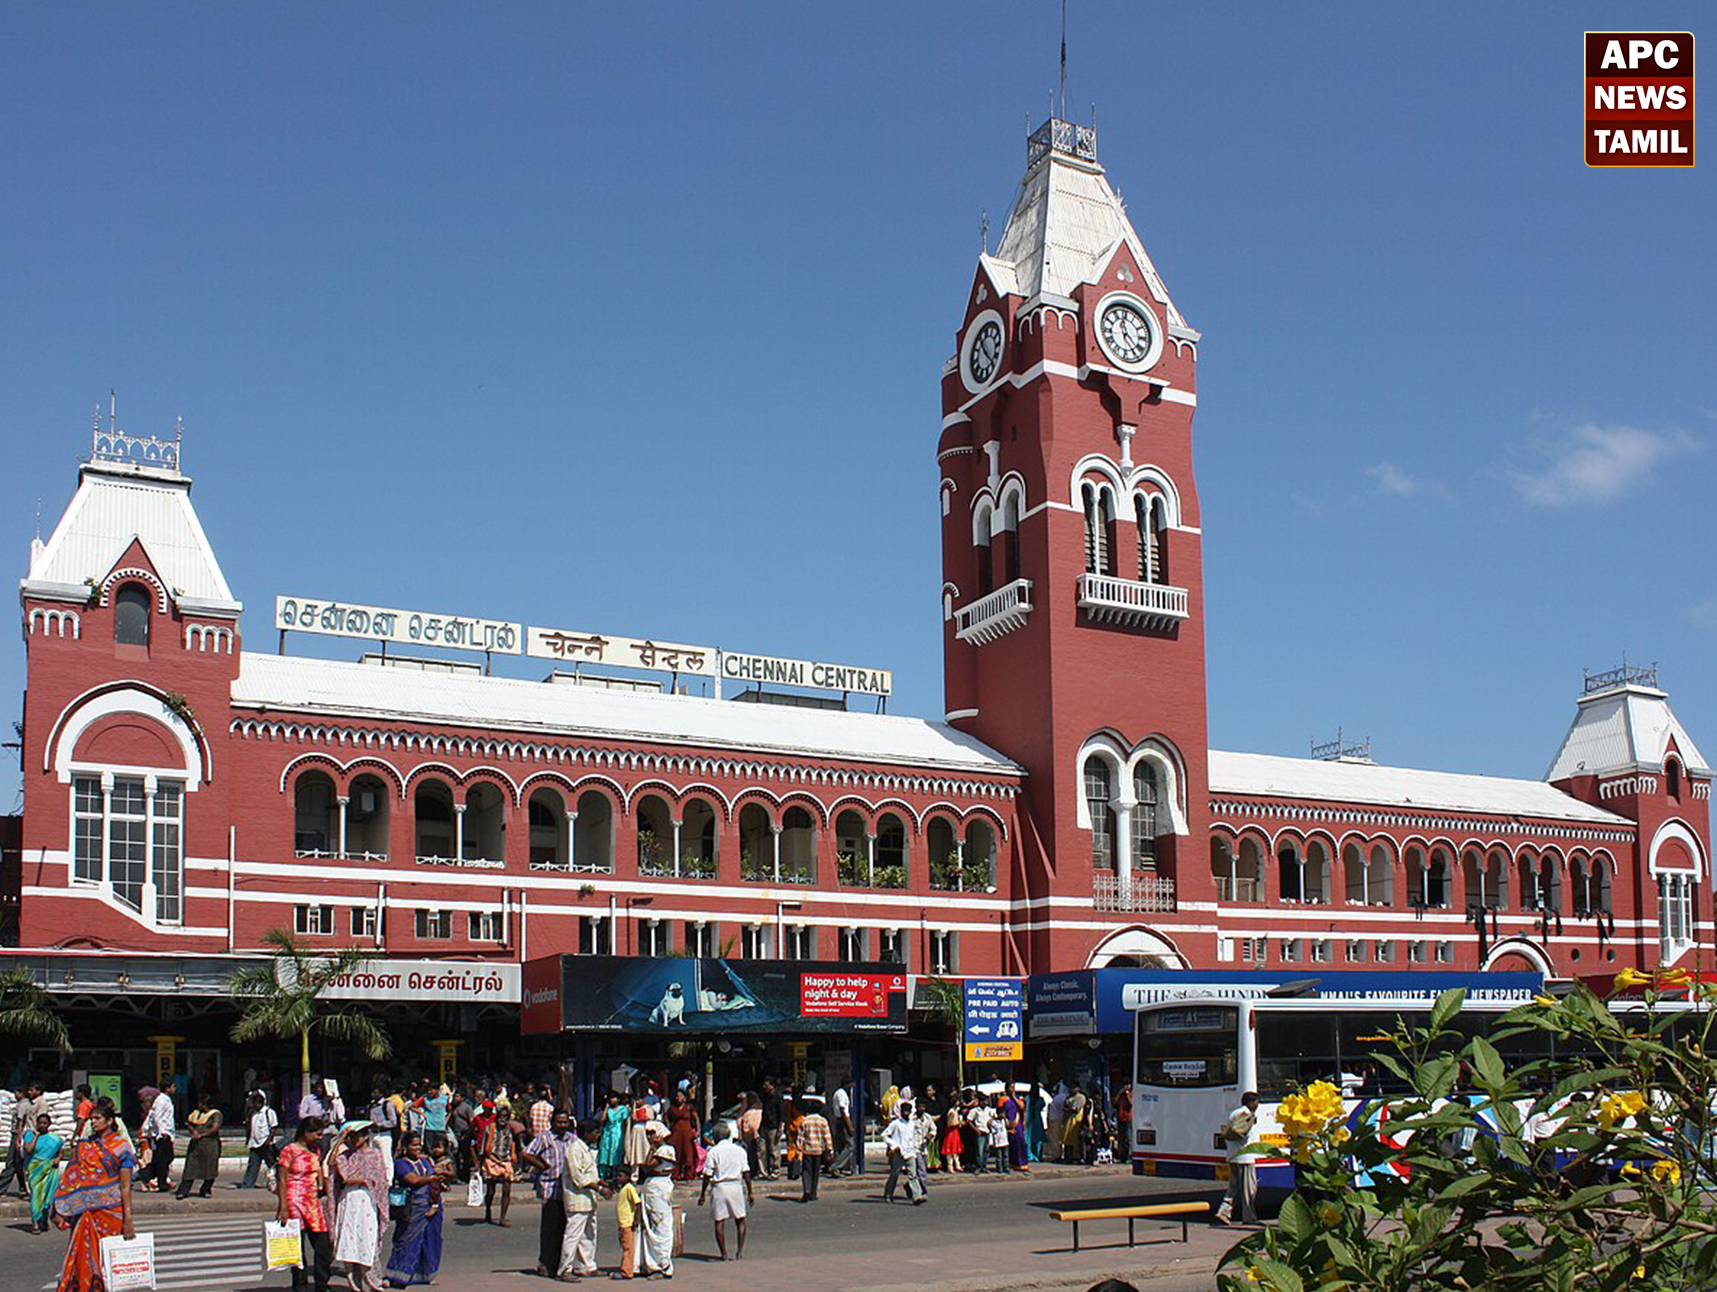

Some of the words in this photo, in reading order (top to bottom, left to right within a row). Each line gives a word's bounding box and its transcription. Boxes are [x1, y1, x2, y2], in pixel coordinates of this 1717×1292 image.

[280, 599, 398, 637] சென்னை
[408, 614, 516, 651] சென்ட்ரல்
[725, 655, 804, 684] CHENNAI
[811, 664, 890, 694] CENTRAL
[408, 969, 503, 994] சென்ட்ரல்
[804, 976, 834, 988] Happy
[836, 977, 846, 986] to
[847, 976, 868, 988] help
[804, 989, 830, 1000] night
[831, 989, 839, 999] &
[840, 989, 858, 1000] day
[1133, 989, 1171, 1004] THE
[1217, 989, 1268, 999] HIND
[1471, 989, 1532, 1000] NEWSPAPER
[968, 999, 981, 1007] PRE
[982, 999, 998, 1007] PAID
[1000, 999, 1020, 1008] AUTO
